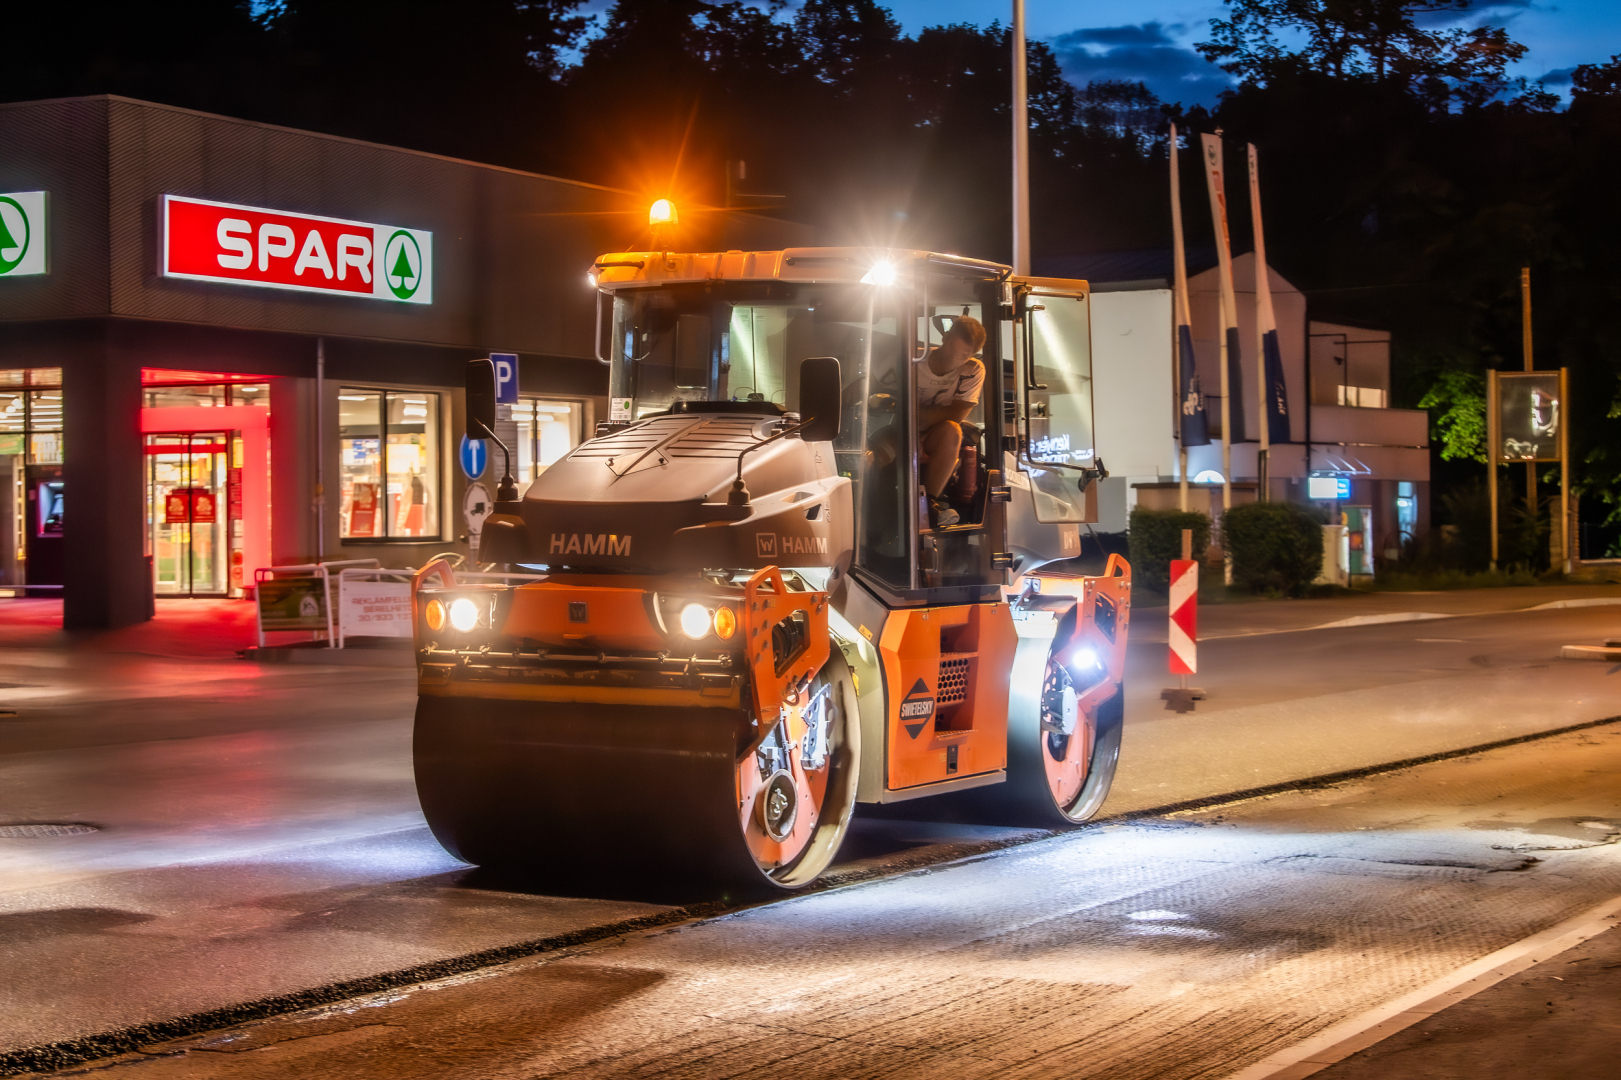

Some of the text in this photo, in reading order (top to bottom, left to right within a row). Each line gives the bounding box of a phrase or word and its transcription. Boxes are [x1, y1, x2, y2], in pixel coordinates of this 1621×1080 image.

[217, 217, 373, 284] SPAR
[496, 361, 512, 398] P
[550, 533, 632, 557] HAMM
[782, 537, 828, 554] HAMM
